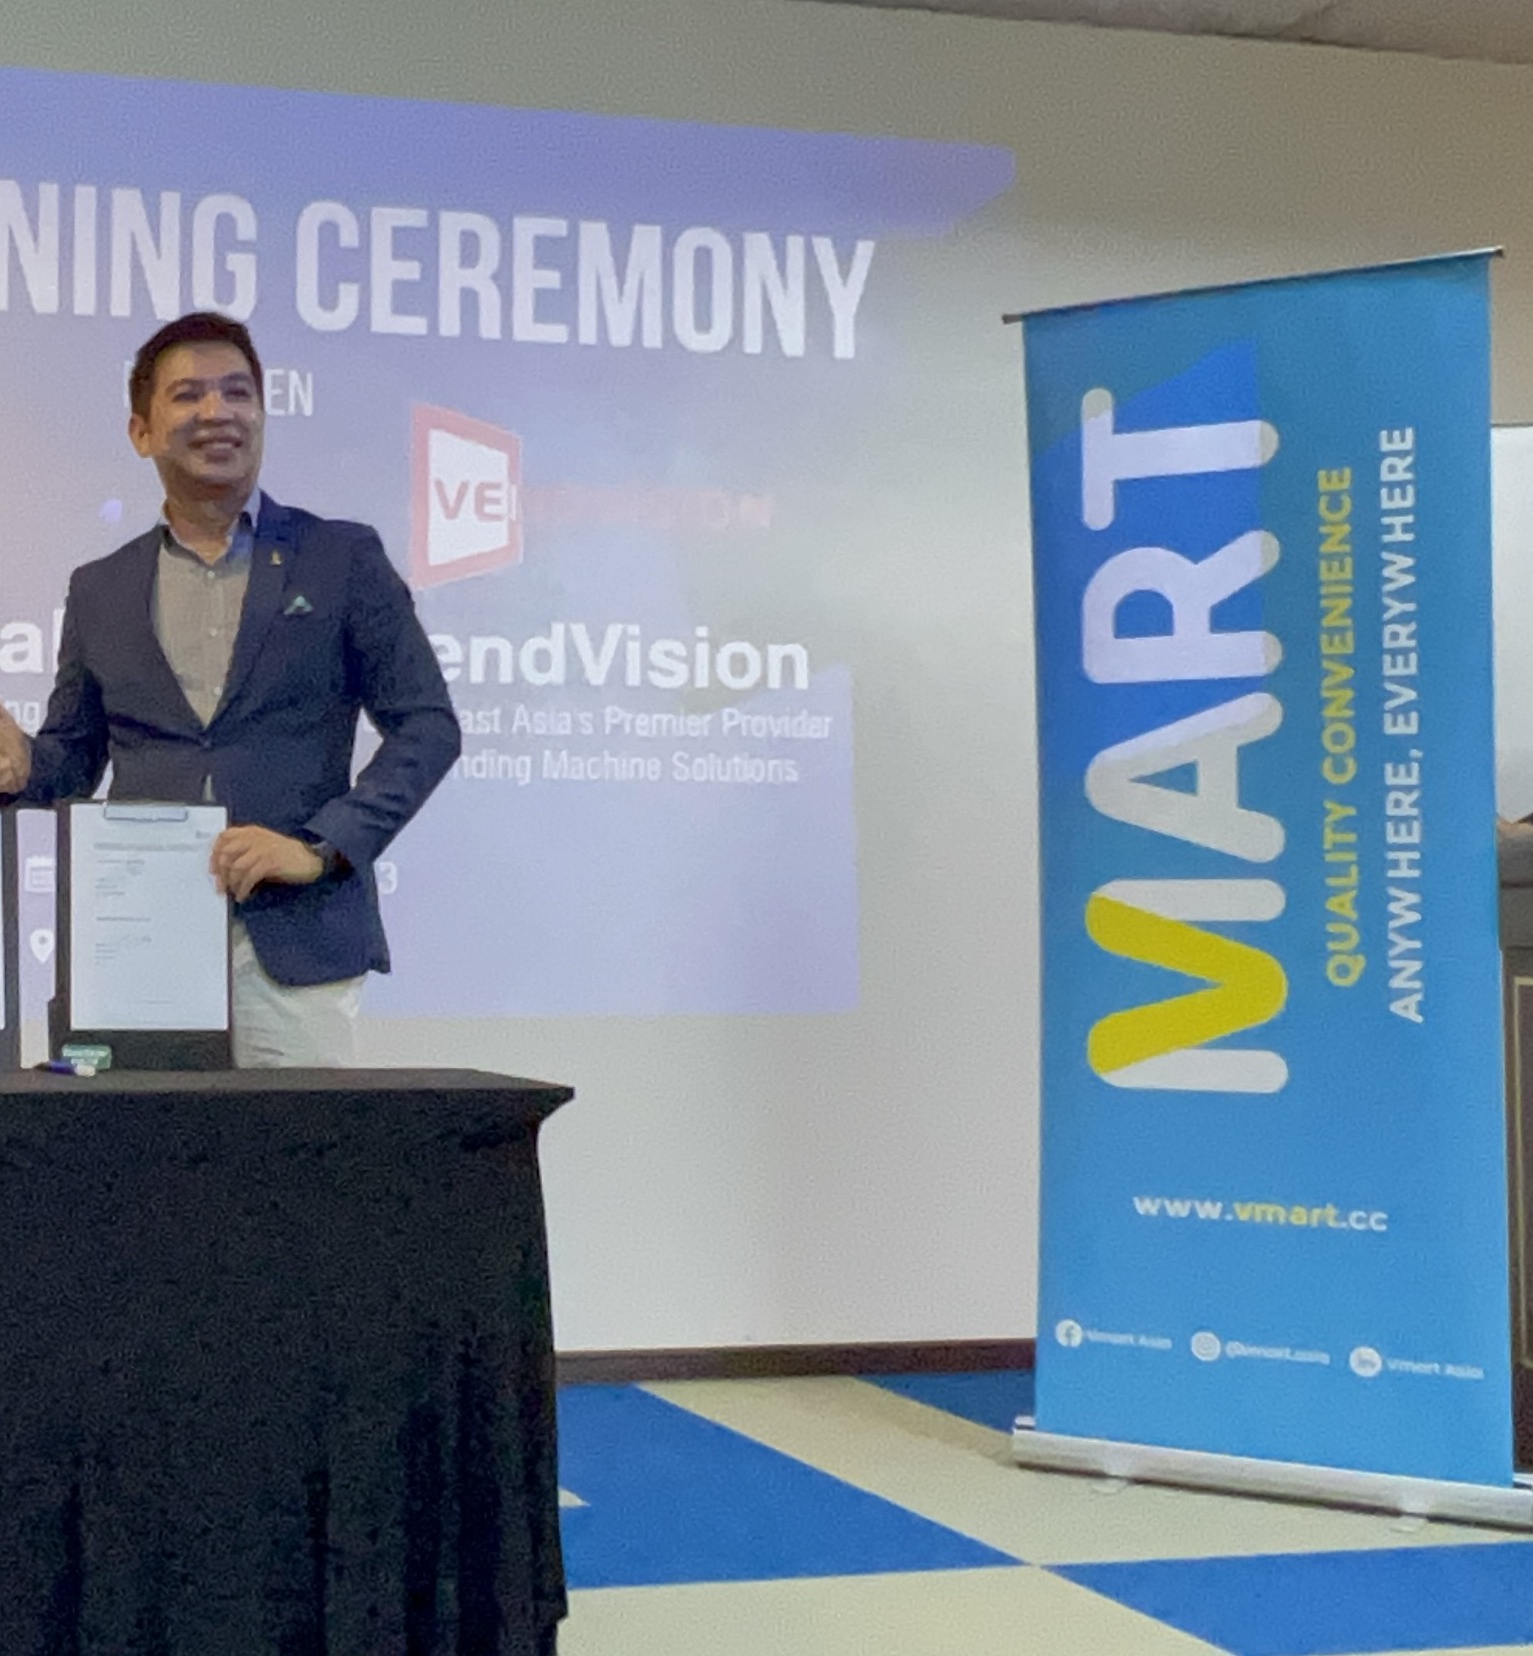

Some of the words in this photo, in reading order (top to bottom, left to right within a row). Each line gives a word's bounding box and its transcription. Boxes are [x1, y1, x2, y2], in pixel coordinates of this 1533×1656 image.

[296, 200, 875, 359] CEREMONY
[1318, 467, 1358, 784] CONVENIENCE
[1380, 425, 1420, 734] EVERYWHERE
[429, 622, 809, 690] endVision
[460, 707, 501, 735] ast
[512, 706, 594, 736] Asia's
[605, 706, 714, 737] Premier
[723, 707, 833, 740] Provider
[542, 750, 662, 782] Machine
[671, 752, 800, 783] Solutions
[1324, 804, 1365, 987] QUALITY
[1133, 1196, 1388, 1233] www.vmart.cc
